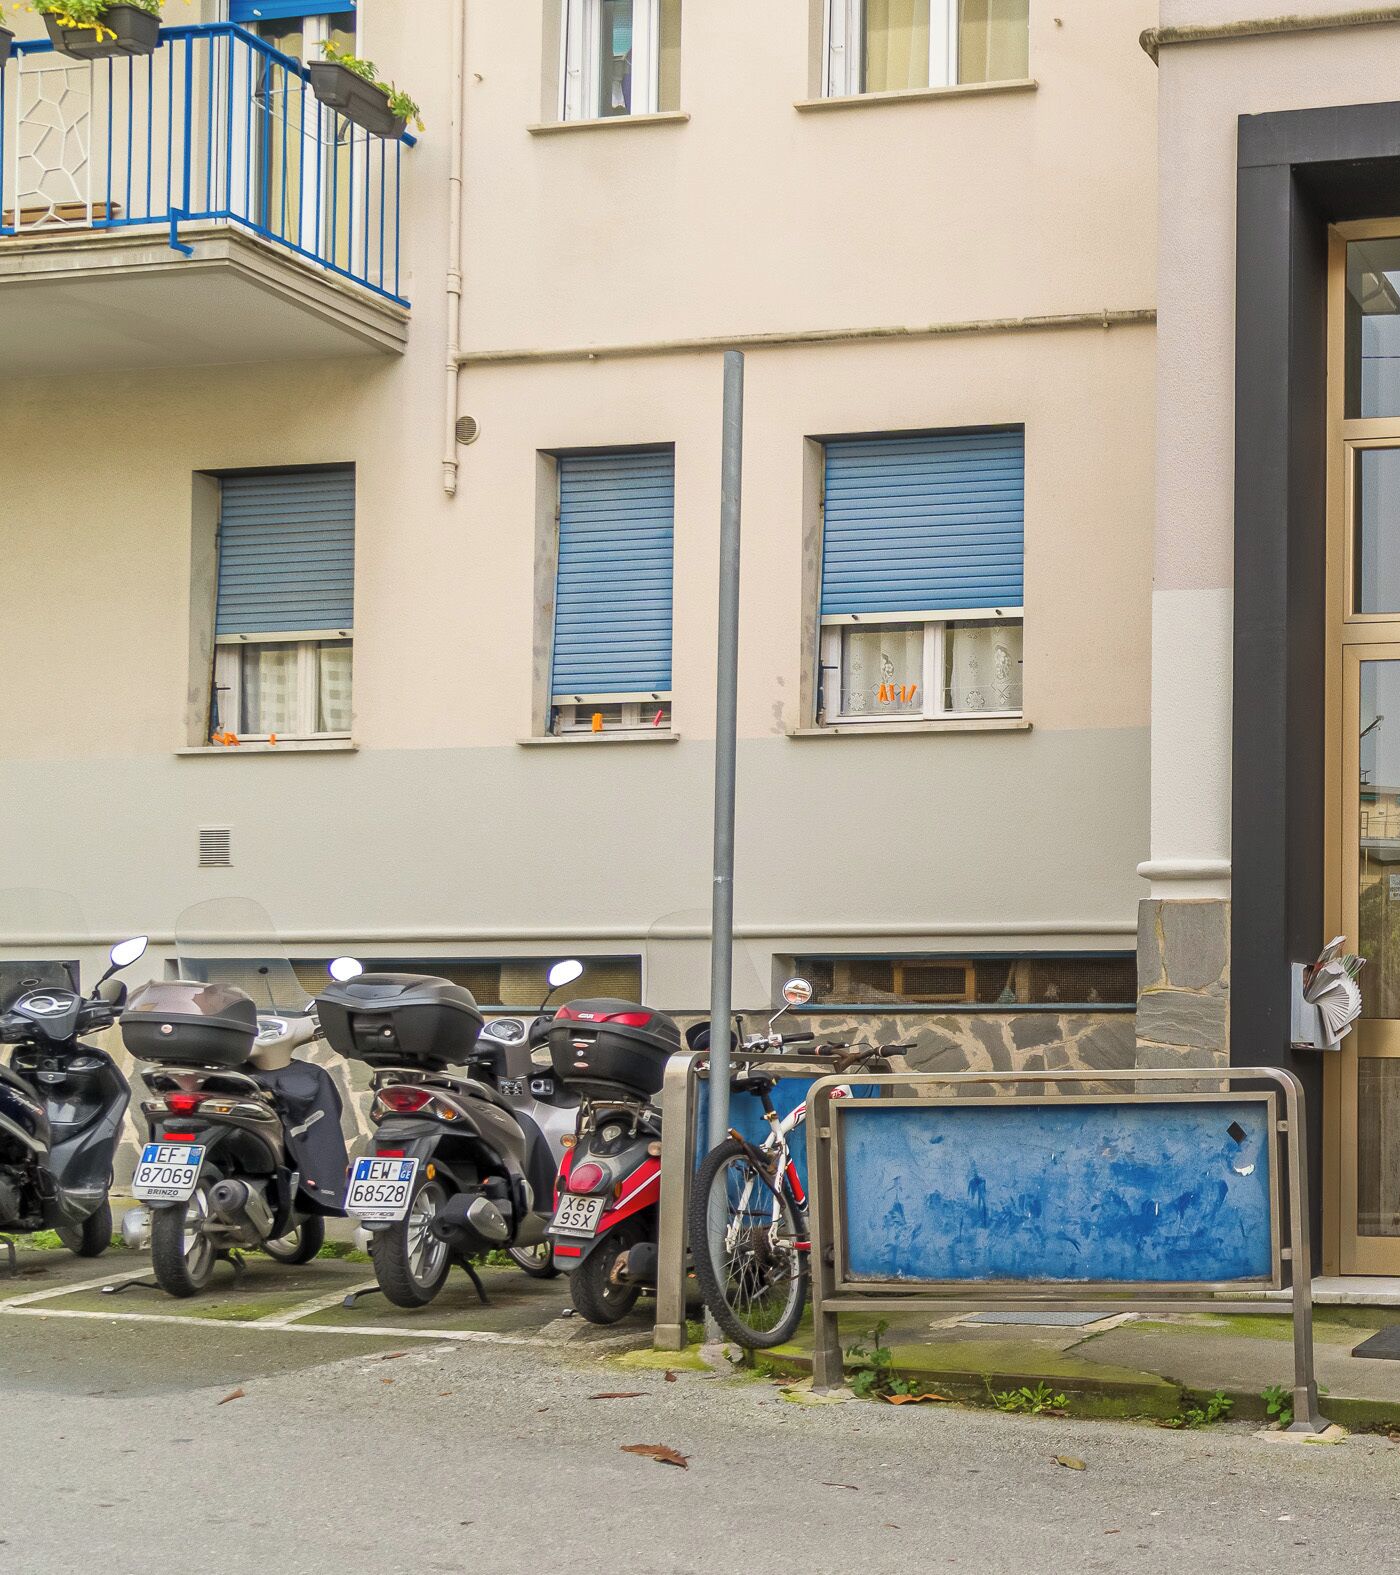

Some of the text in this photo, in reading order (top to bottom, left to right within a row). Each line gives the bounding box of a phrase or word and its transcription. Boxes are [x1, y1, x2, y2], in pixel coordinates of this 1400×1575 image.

[157, 1147, 181, 1162] EF
[140, 1167, 194, 1185] 87069
[370, 1162, 392, 1179] EW
[400, 1170, 411, 1179] GE
[147, 1188, 179, 1196] BRINZO
[353, 1185, 405, 1202] 68528
[565, 1197, 597, 1213] X66
[560, 1212, 592, 1228] 9SX
